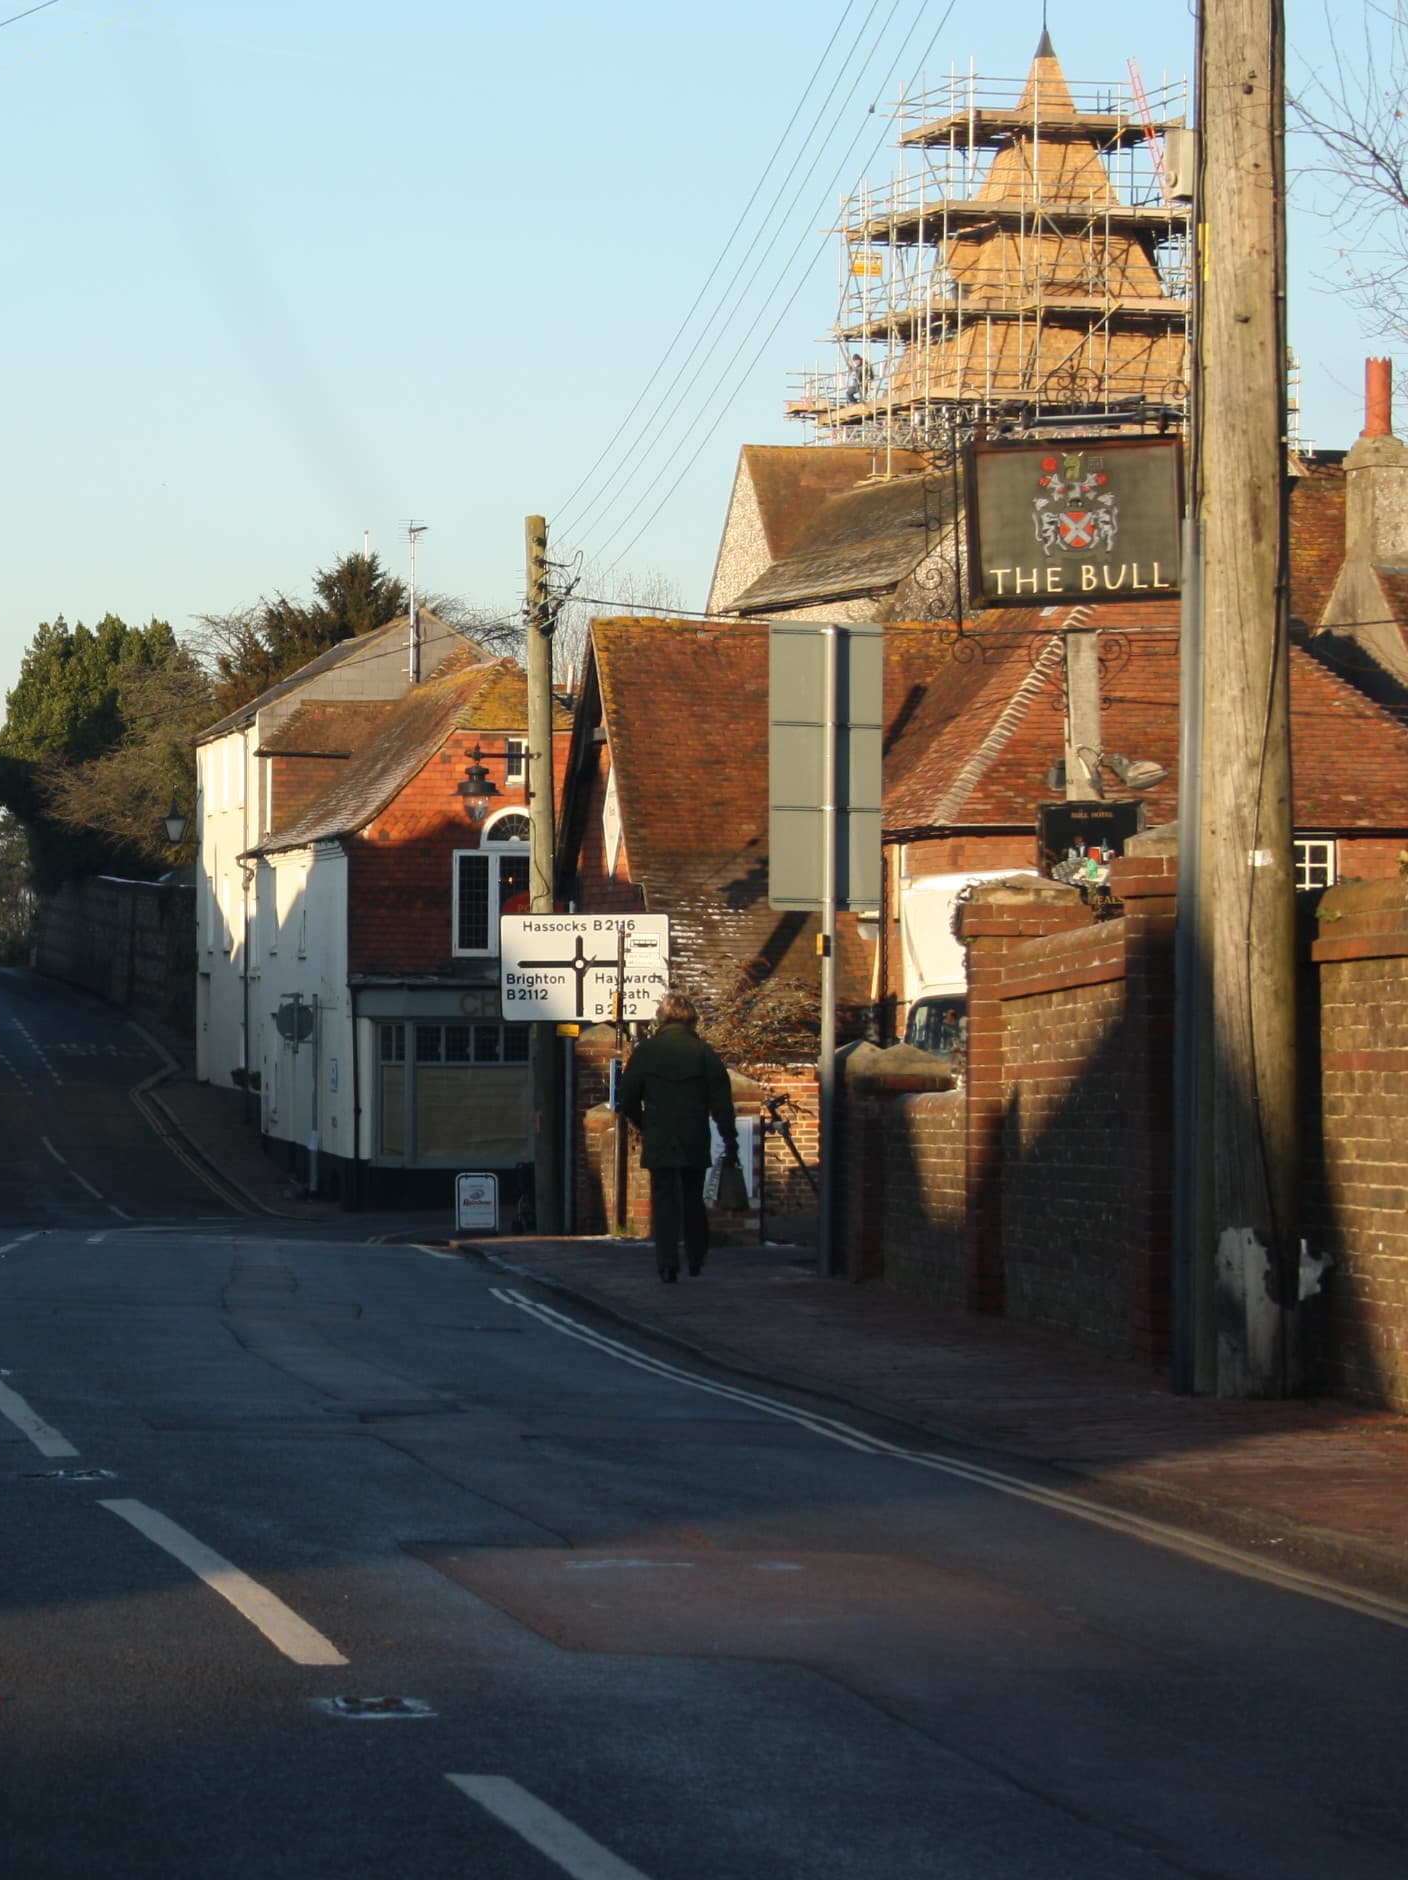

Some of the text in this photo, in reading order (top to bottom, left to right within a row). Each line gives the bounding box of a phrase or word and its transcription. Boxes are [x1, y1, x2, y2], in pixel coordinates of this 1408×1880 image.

[989, 562, 1170, 594] THE BULL
[522, 920, 587, 932] Hassocks
[506, 973, 566, 987] Brighton
